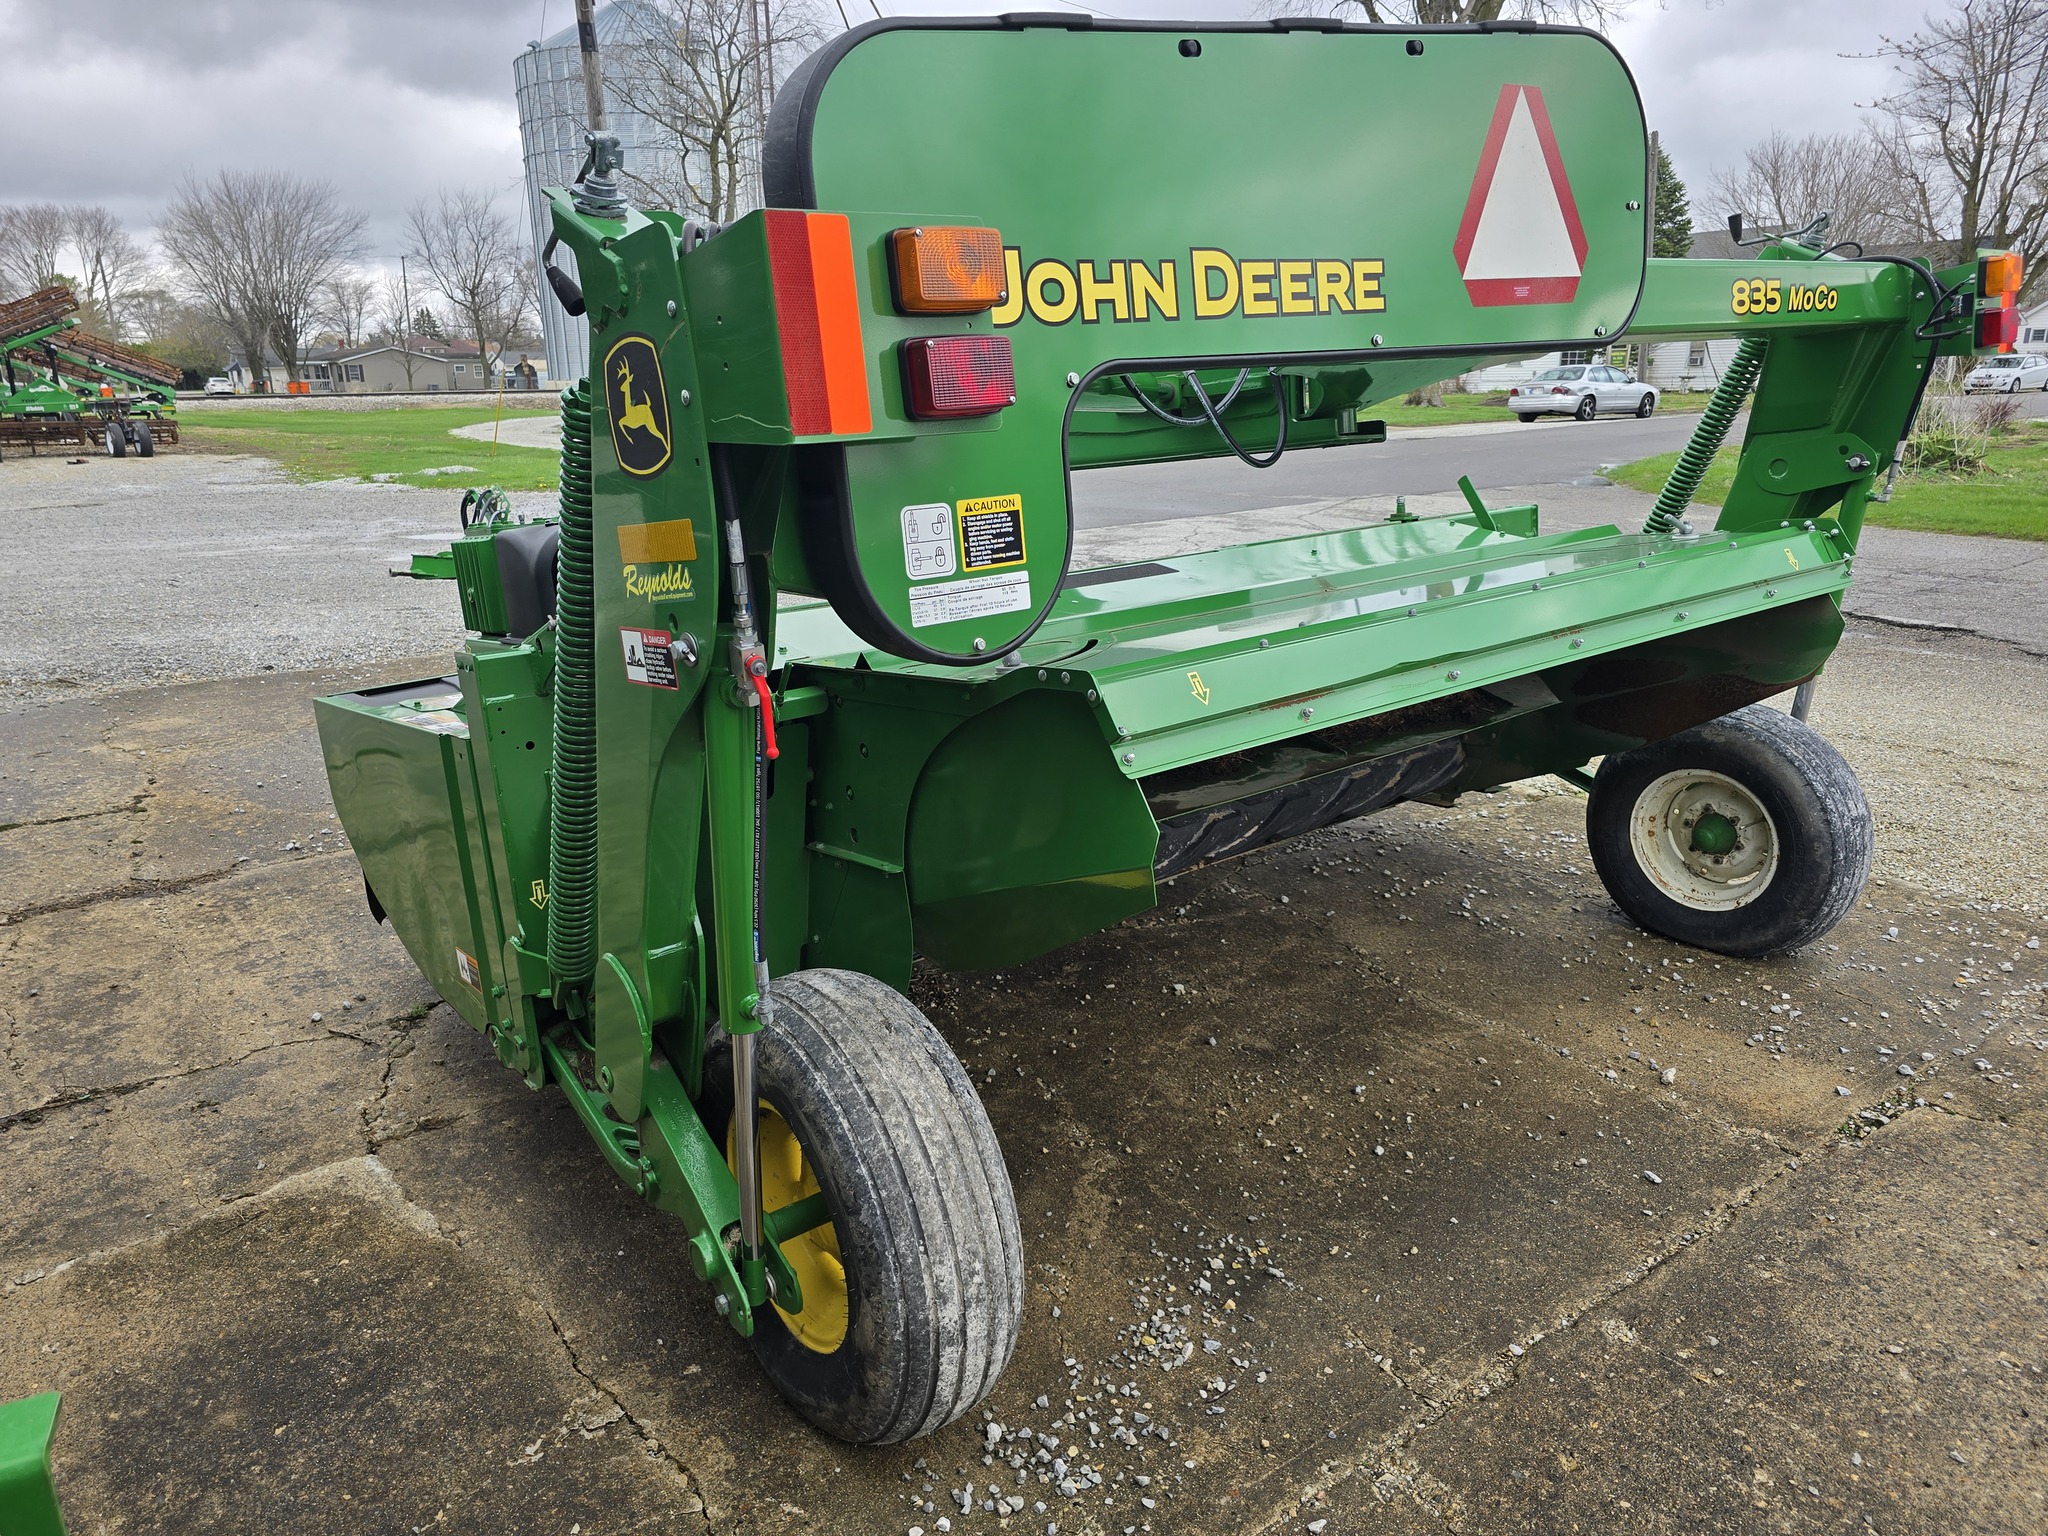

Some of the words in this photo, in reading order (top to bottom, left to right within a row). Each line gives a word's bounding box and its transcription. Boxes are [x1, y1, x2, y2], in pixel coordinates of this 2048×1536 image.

[993, 246, 1180, 327] JOHN
[1190, 247, 1387, 320] DEERE
[1732, 277, 1782, 316] 835
[1787, 282, 1838, 313] MoCo
[973, 498, 1015, 512] CAUTION
[623, 563, 691, 603] Reynolds
[648, 636, 667, 645] DANGER
